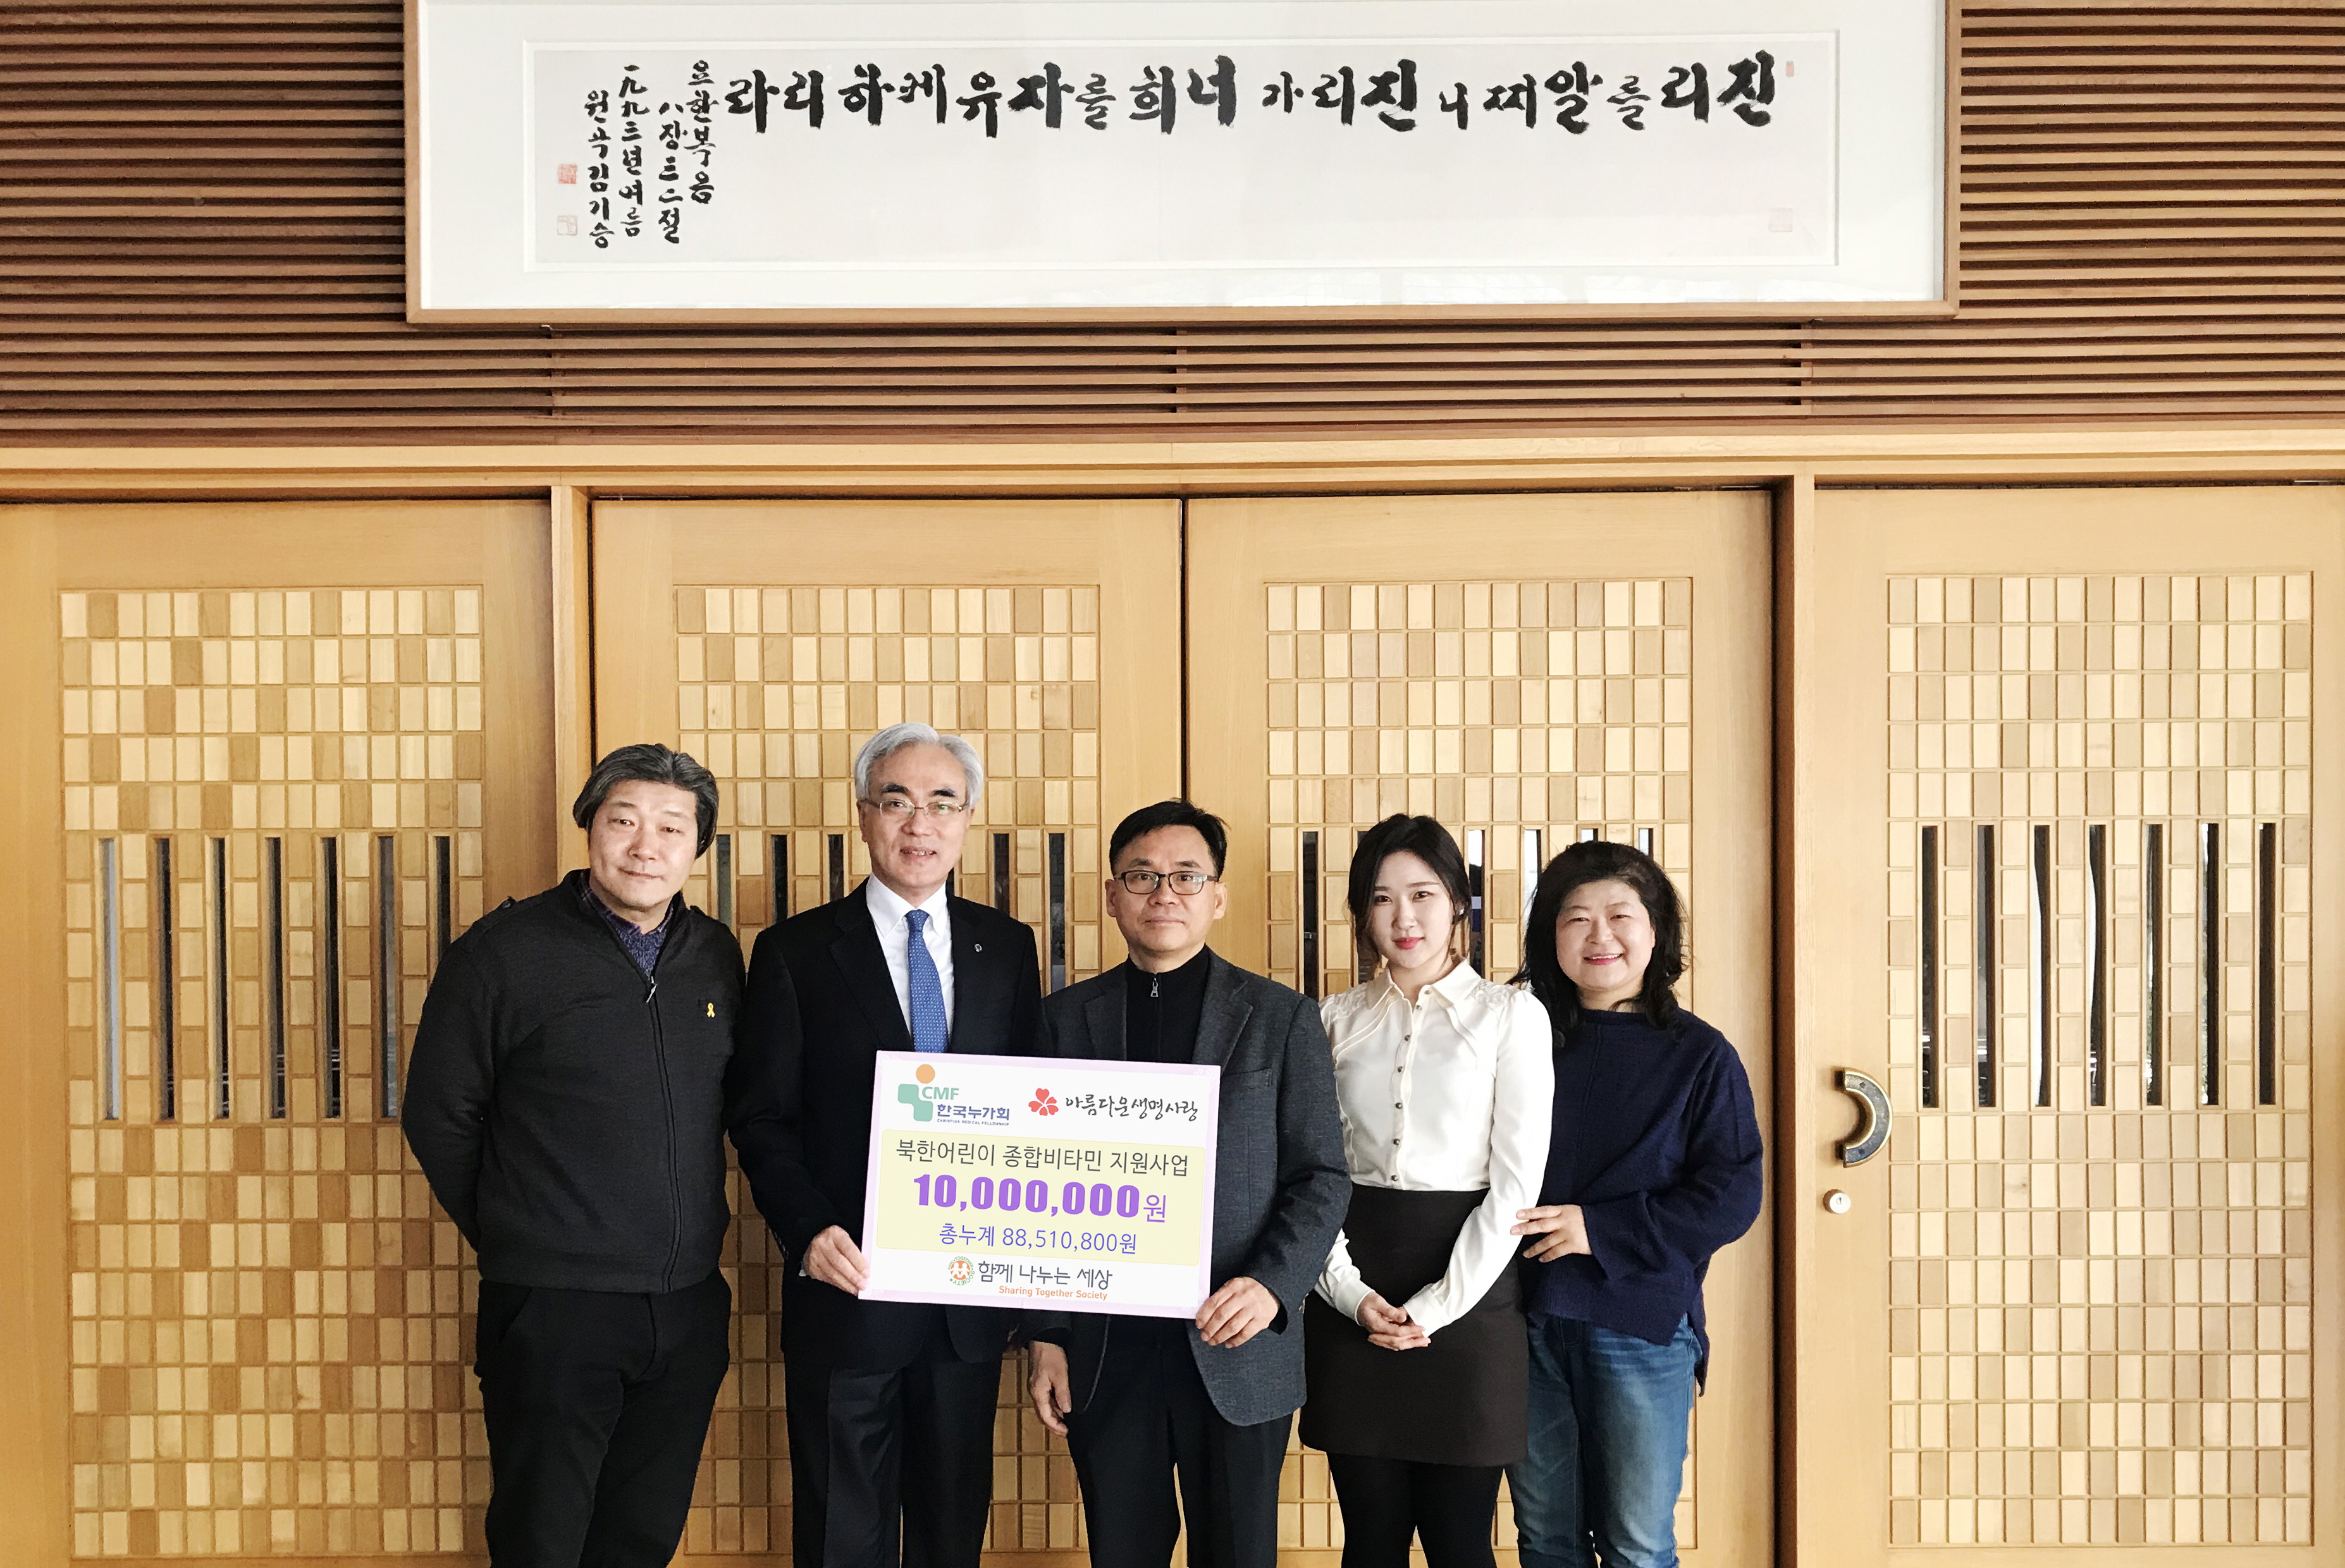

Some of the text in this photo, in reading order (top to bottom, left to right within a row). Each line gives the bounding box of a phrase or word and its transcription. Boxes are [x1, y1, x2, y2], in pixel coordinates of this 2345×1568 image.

[921, 1086, 959, 1100] CMF
[937, 1104, 1010, 1120] 한국누가회
[896, 1139, 1188, 1177] 북한어린이 종합비타민 지원사업
[914, 1174, 1166, 1223] 10,000,000원
[939, 1223, 1136, 1254] 총누계 88,510,800원
[952, 1270, 975, 1286] SOCIETY
[978, 1261, 1113, 1290] 함께 나누는 세상
[999, 1285, 1108, 1301] Sharing Together Society
